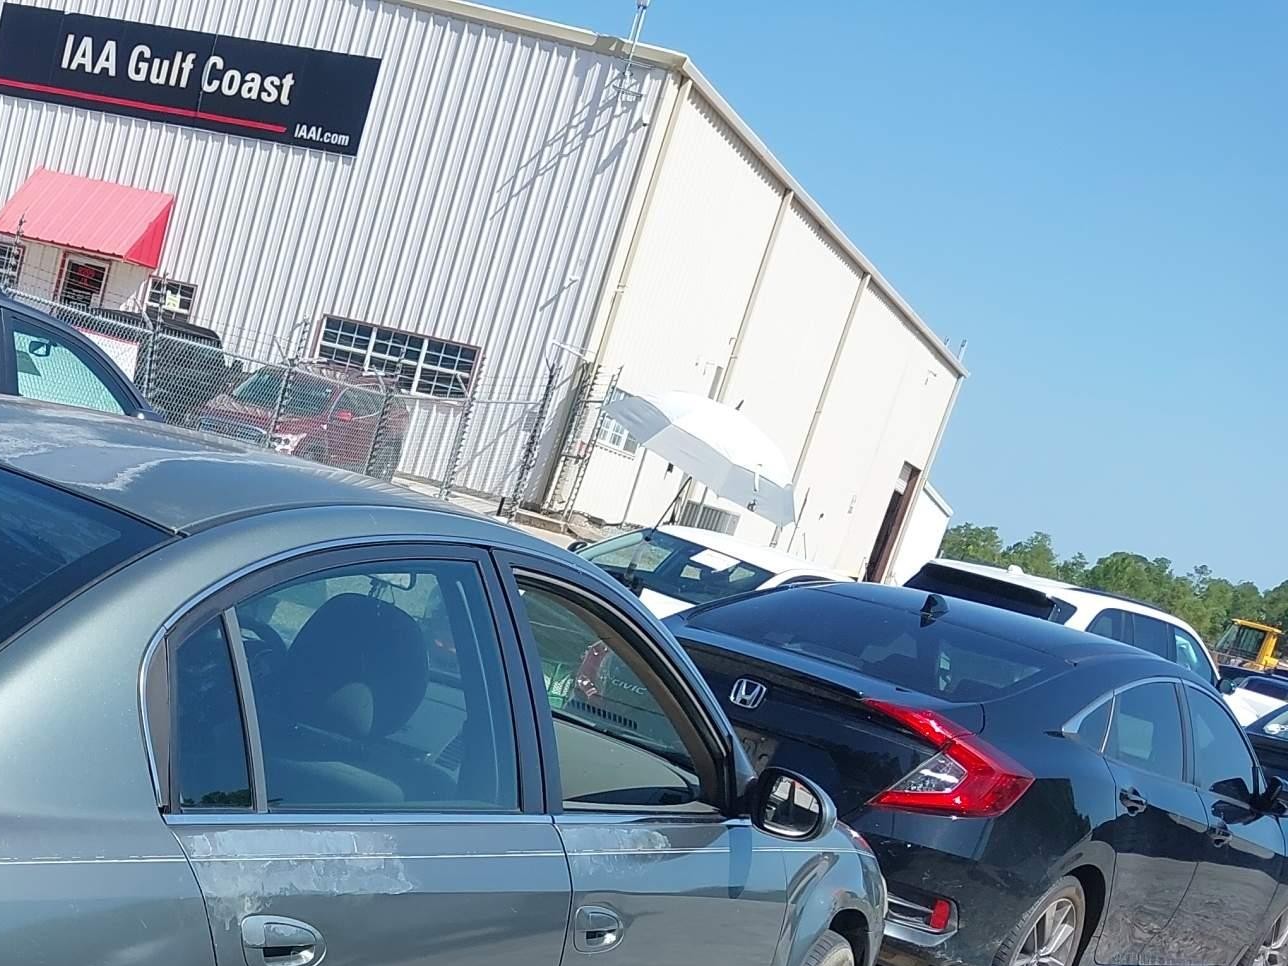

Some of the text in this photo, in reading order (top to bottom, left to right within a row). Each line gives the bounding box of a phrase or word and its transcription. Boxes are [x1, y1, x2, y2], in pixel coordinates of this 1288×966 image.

[61, 33, 295, 106] IAA Gulf Coast
[294, 123, 350, 146] IAAI.com
[611, 676, 648, 695] CIVIC
